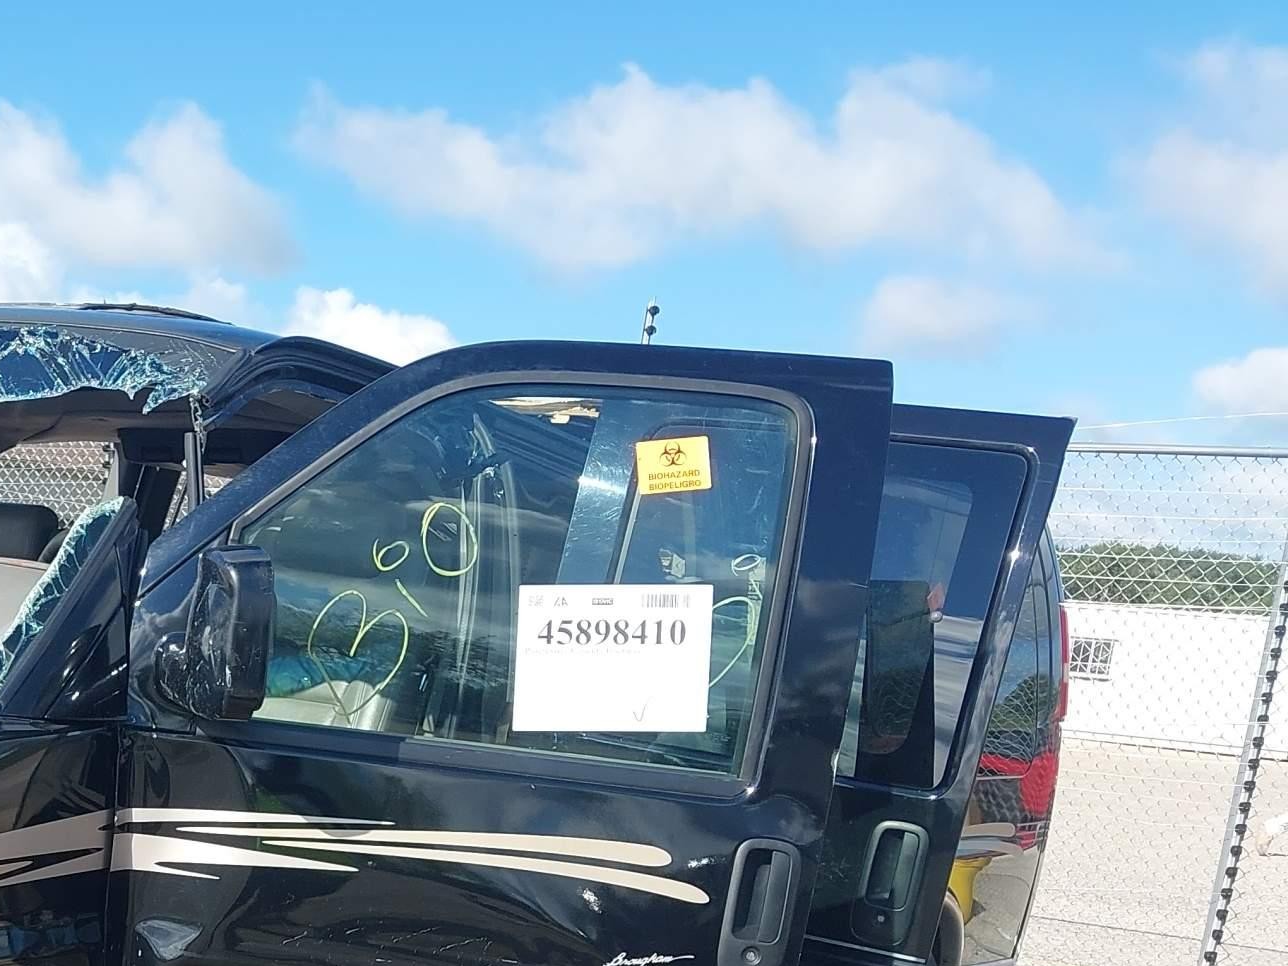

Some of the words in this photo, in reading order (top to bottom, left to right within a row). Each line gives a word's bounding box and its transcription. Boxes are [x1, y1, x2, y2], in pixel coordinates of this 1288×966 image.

[648, 469, 701, 481] BIOHAZARD
[648, 479, 702, 491] BIOPELIGRO
[537, 619, 687, 646] 45898410
